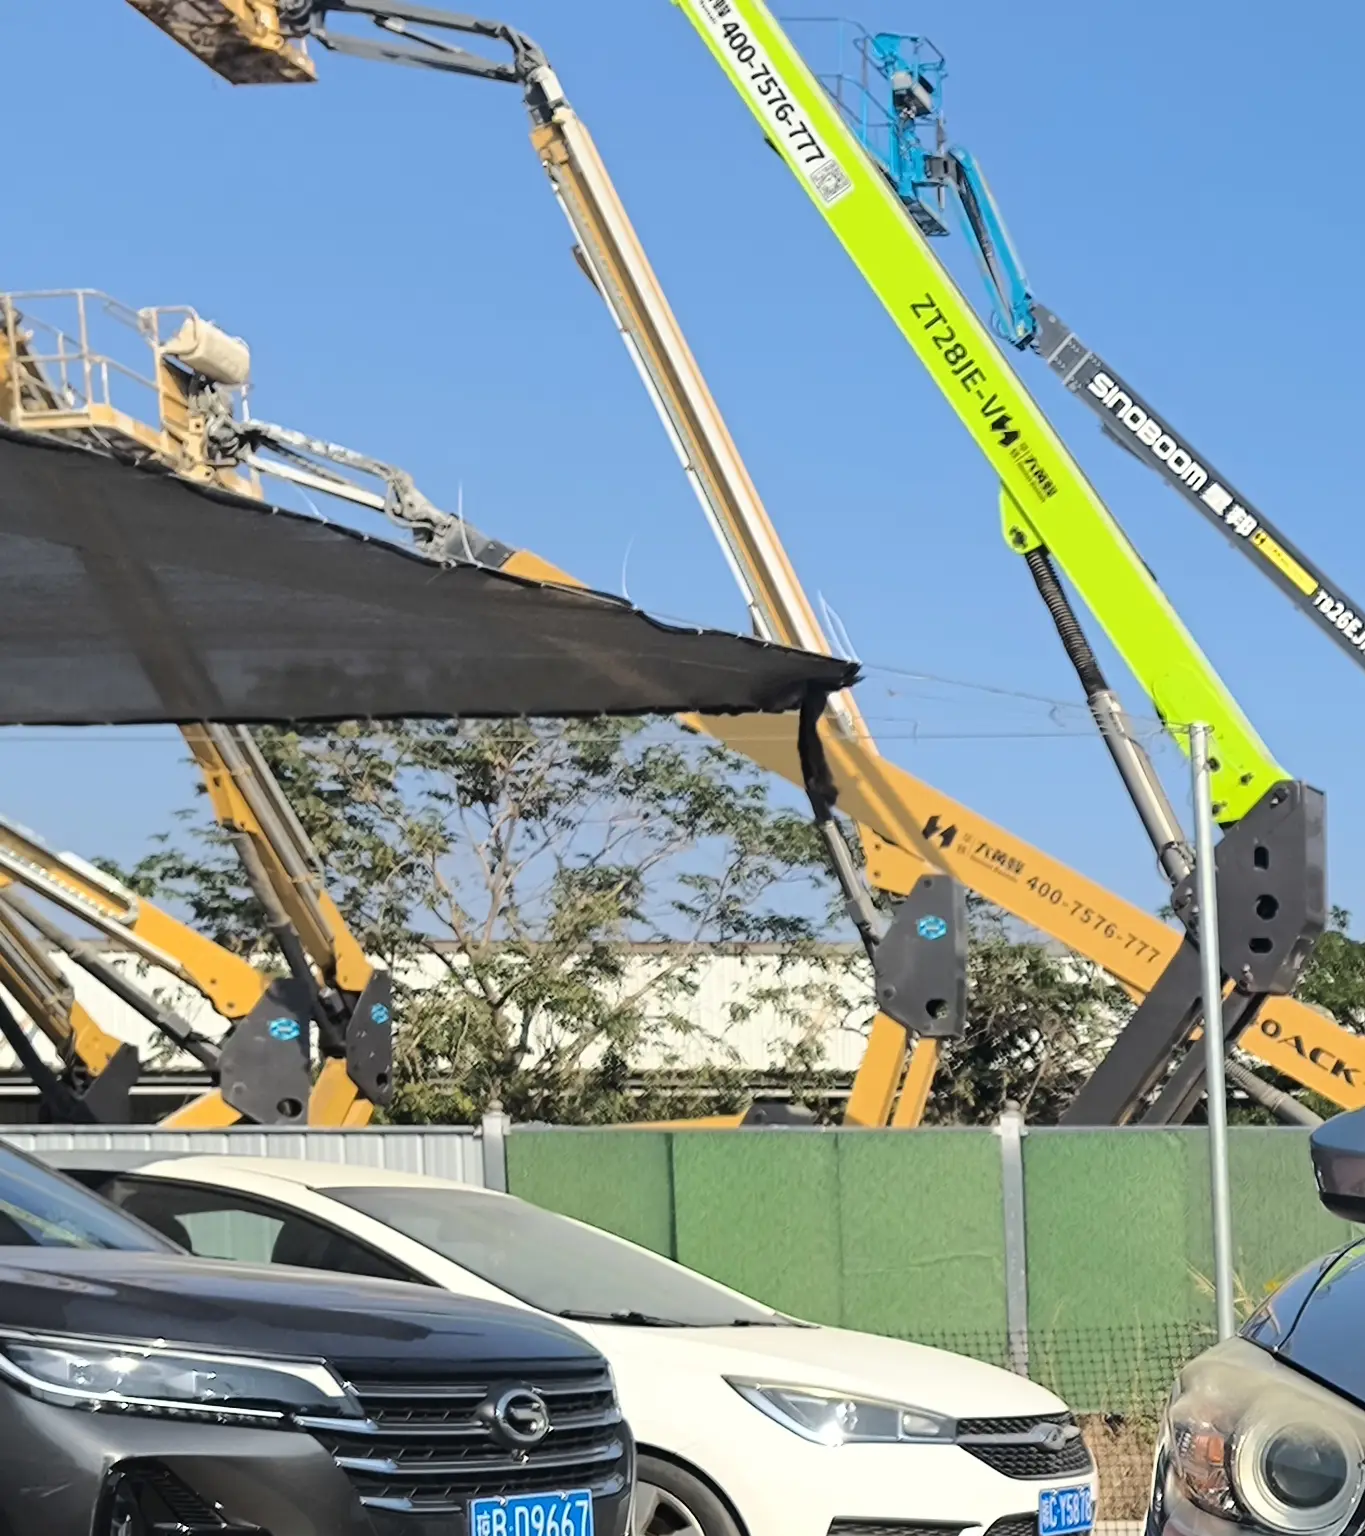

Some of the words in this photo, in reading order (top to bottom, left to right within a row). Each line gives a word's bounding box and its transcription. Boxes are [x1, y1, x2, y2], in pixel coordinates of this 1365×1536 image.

[722, 22, 825, 163] 400-7576-777
[1087, 372, 1208, 491] SINOBOOM
[1026, 875, 1161, 964] 400-7576-777
